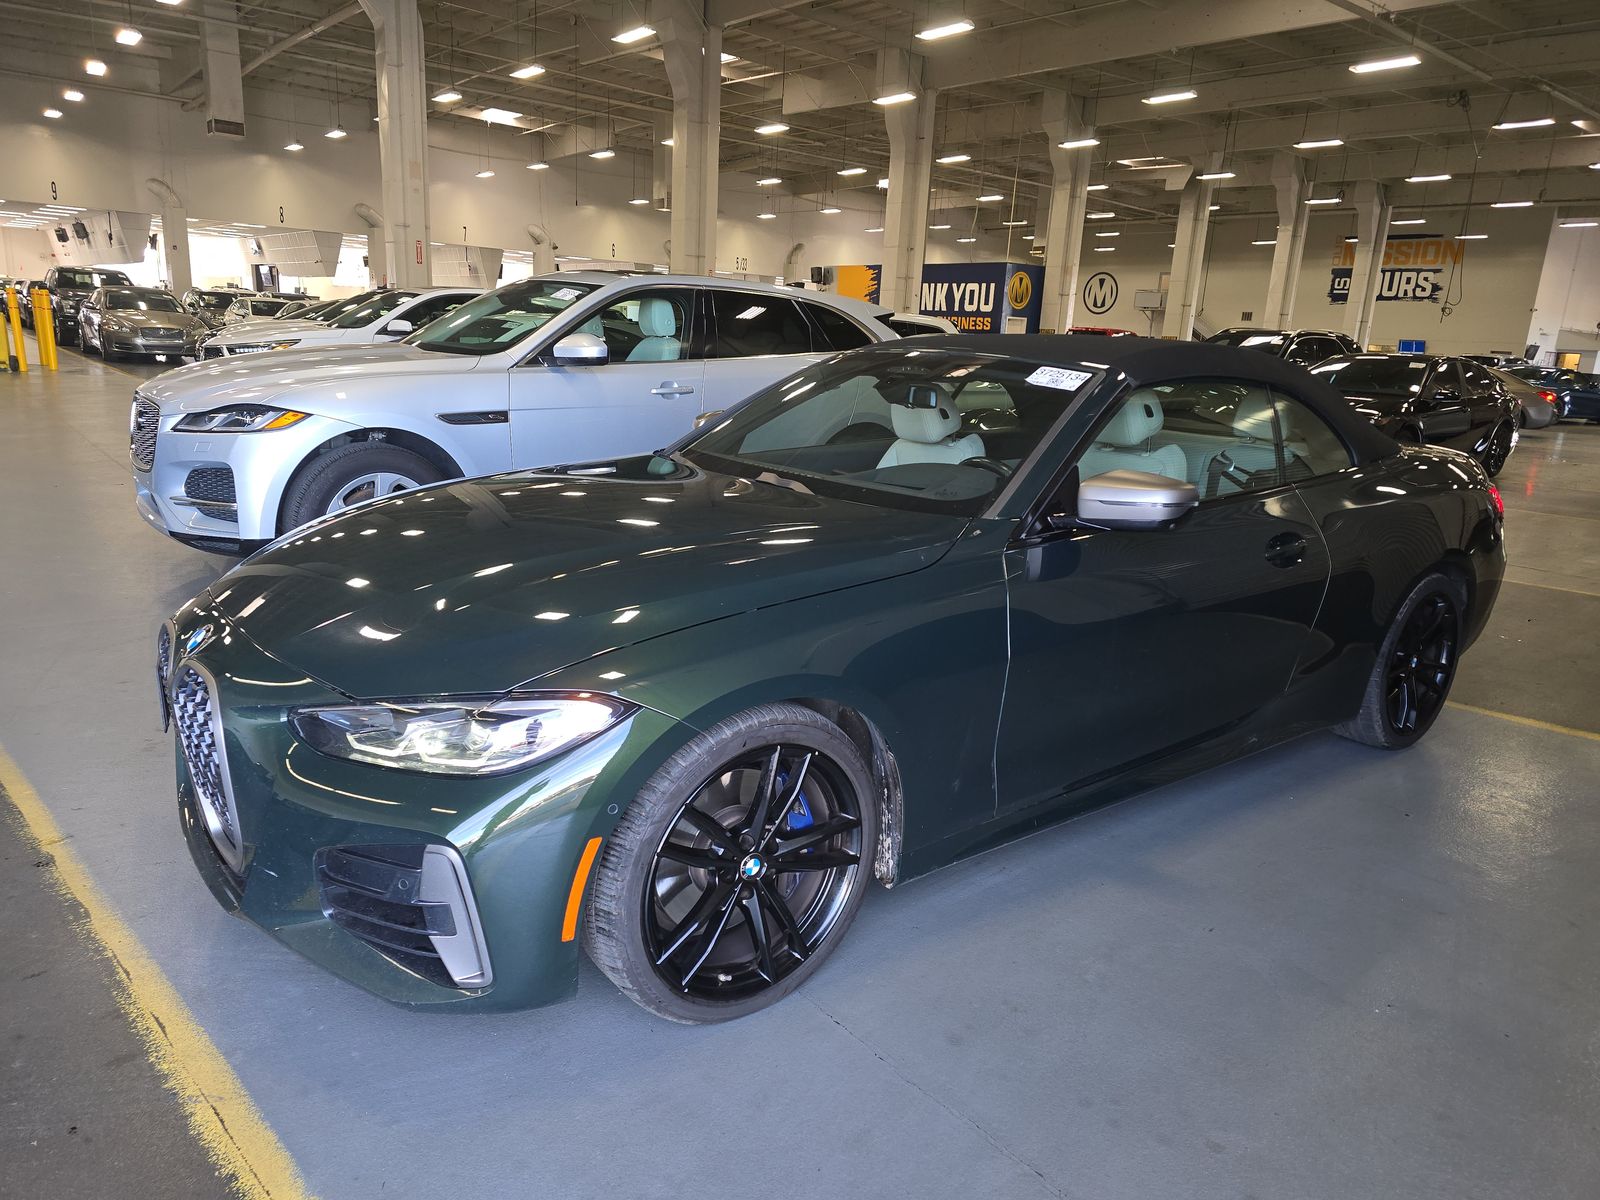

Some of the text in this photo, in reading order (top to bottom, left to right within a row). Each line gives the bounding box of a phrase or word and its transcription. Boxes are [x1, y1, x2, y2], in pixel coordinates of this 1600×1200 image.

[51, 181, 58, 201] 9
[279, 206, 285, 224] 8
[611, 243, 616, 258] 6
[1341, 239, 1465, 266] MSSION
[1333, 277, 1351, 294] IS
[1376, 271, 1433, 298] URS
[952, 283, 995, 312] YOU
